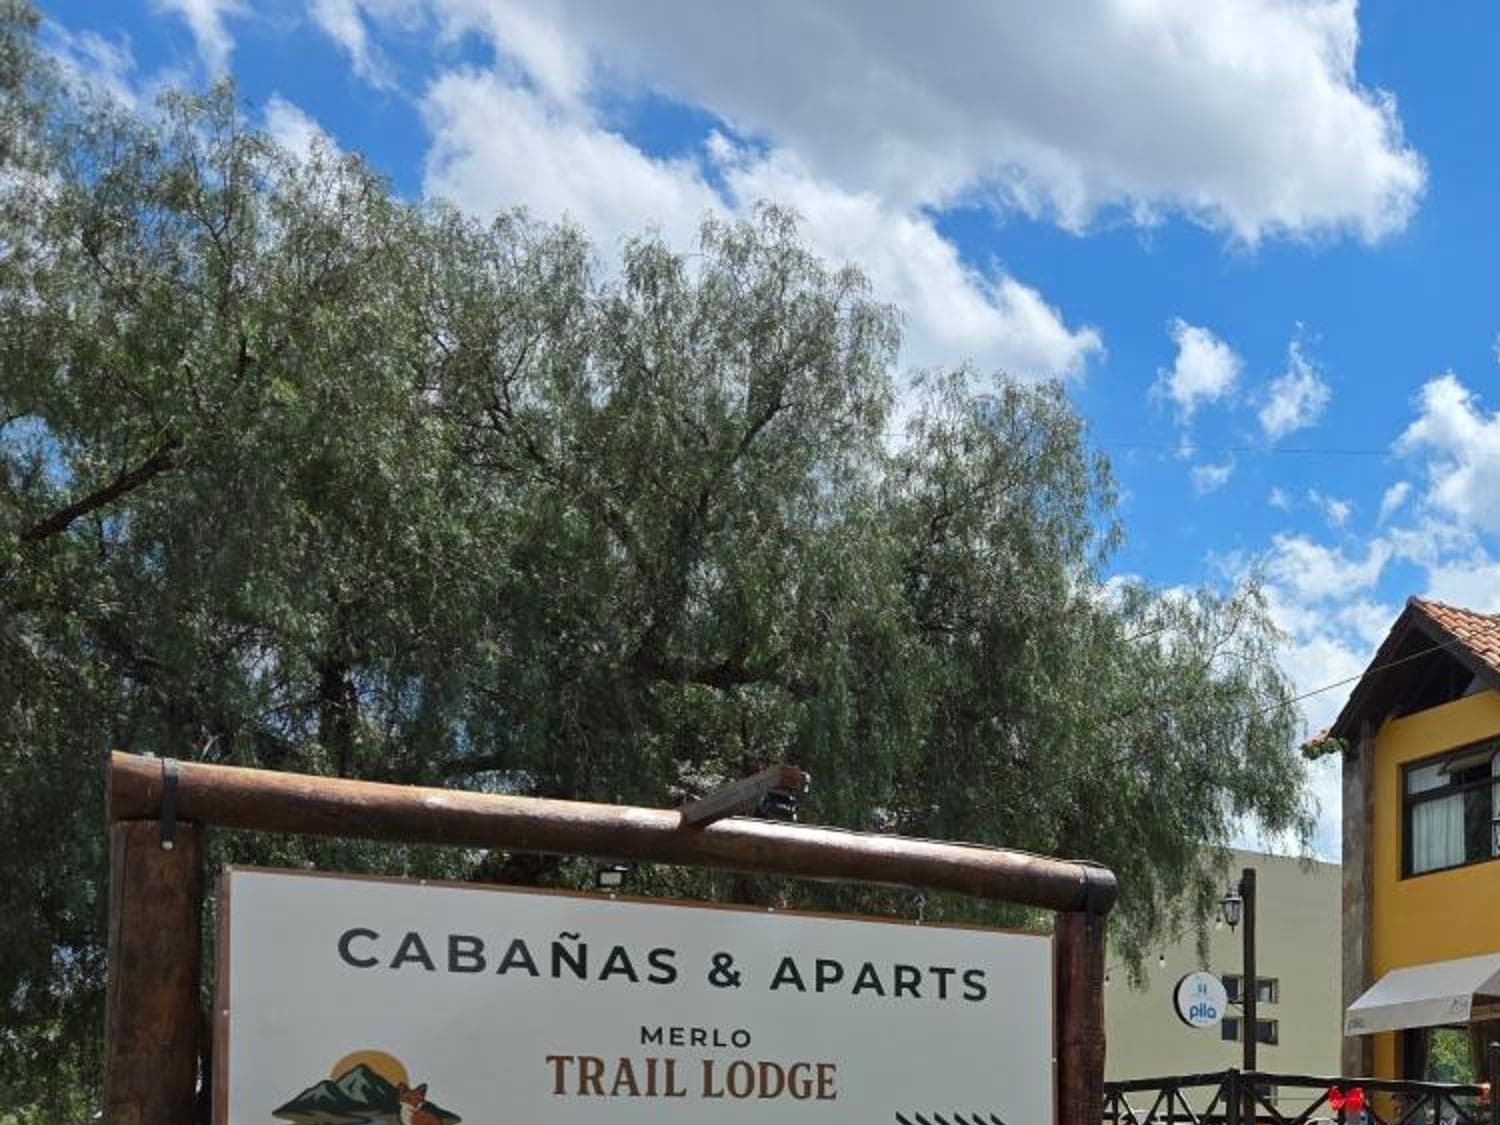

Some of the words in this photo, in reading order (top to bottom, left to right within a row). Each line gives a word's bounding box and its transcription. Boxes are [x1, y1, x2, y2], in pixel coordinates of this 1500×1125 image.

[337, 927, 678, 986] CABAÑAS
[707, 951, 742, 989] &
[768, 956, 988, 1003] APARTS
[1189, 1003, 1217, 1020] pila
[639, 1025, 752, 1049] MERLO
[545, 1054, 688, 1098] TRAIL
[701, 1058, 838, 1101] LODGE
